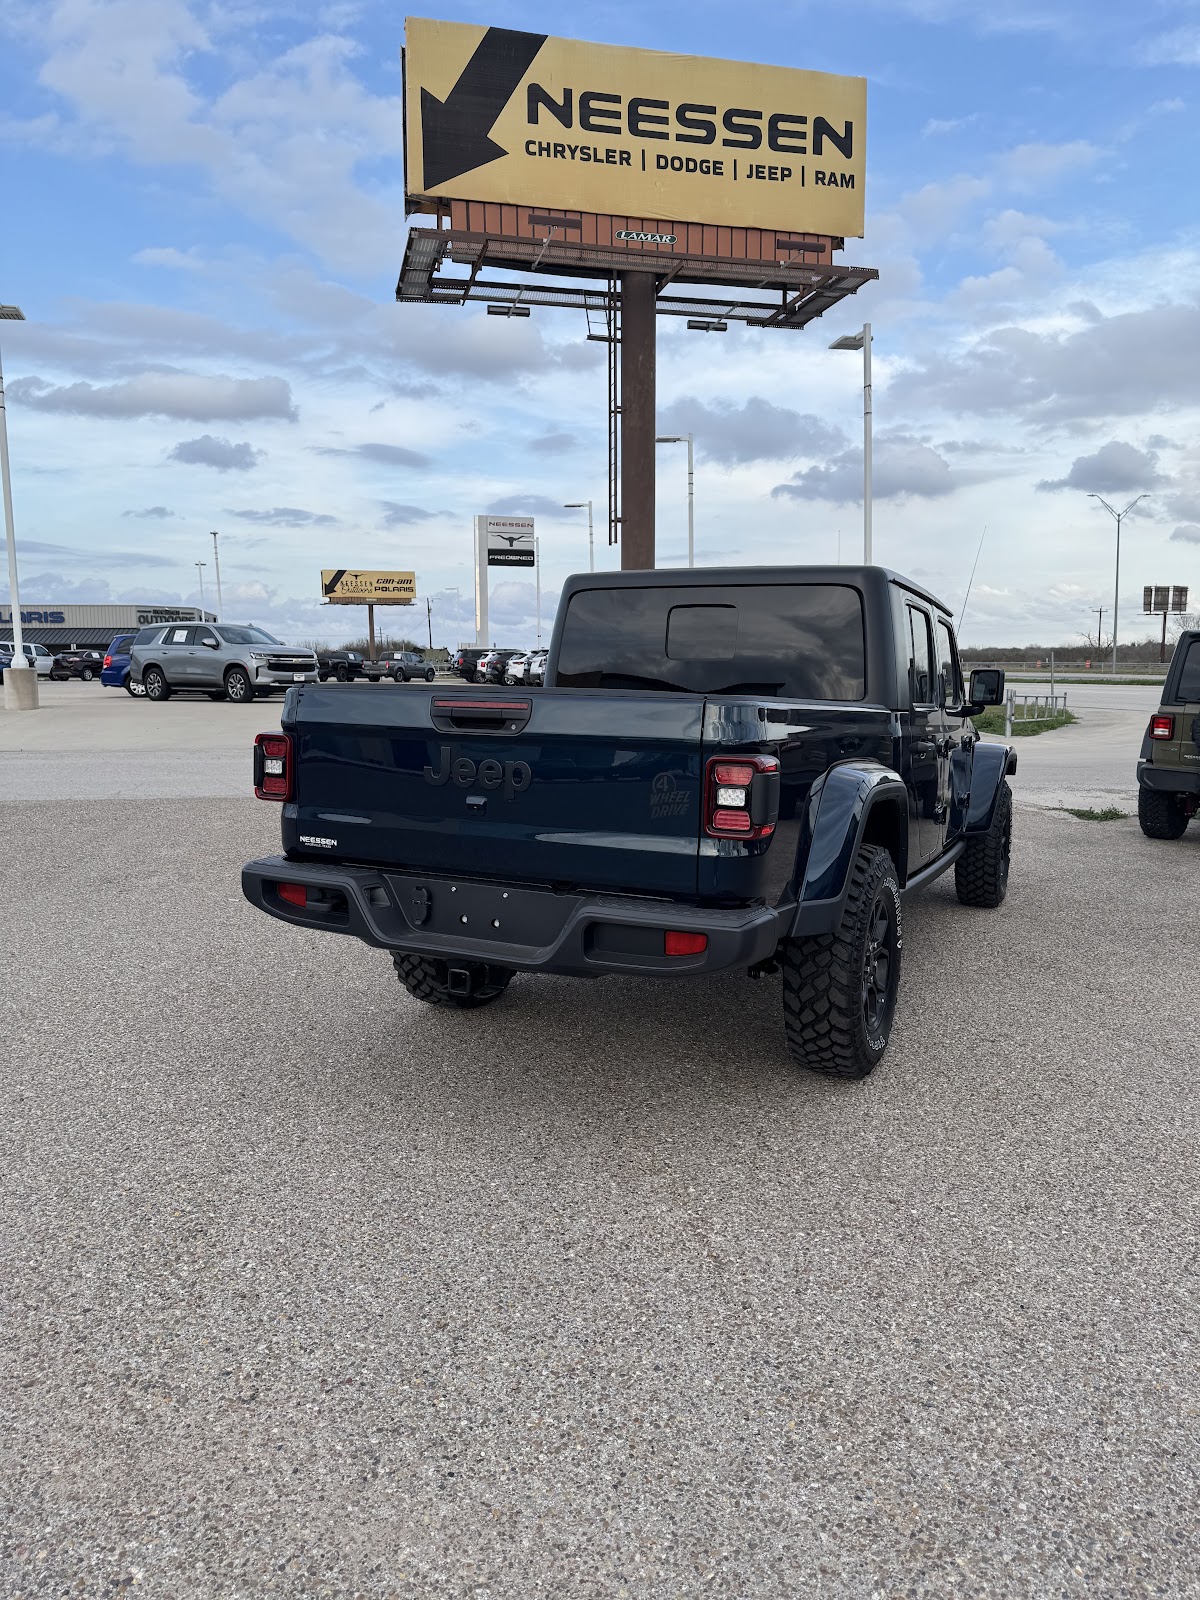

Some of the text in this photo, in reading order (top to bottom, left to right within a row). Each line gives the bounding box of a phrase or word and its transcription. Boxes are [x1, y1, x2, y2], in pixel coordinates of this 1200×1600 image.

[527, 82, 853, 160] NEESSEN
[525, 139, 855, 189] CHRYSLER DODGE JEEP RAM
[620, 231, 672, 243] LAMAR
[340, 580, 373, 588] NEESSEN
[423, 746, 532, 801] Jeep
[650, 790, 691, 806] WHEEL
[650, 803, 690, 820] DRIVE
[300, 835, 337, 847] NEESSEN
